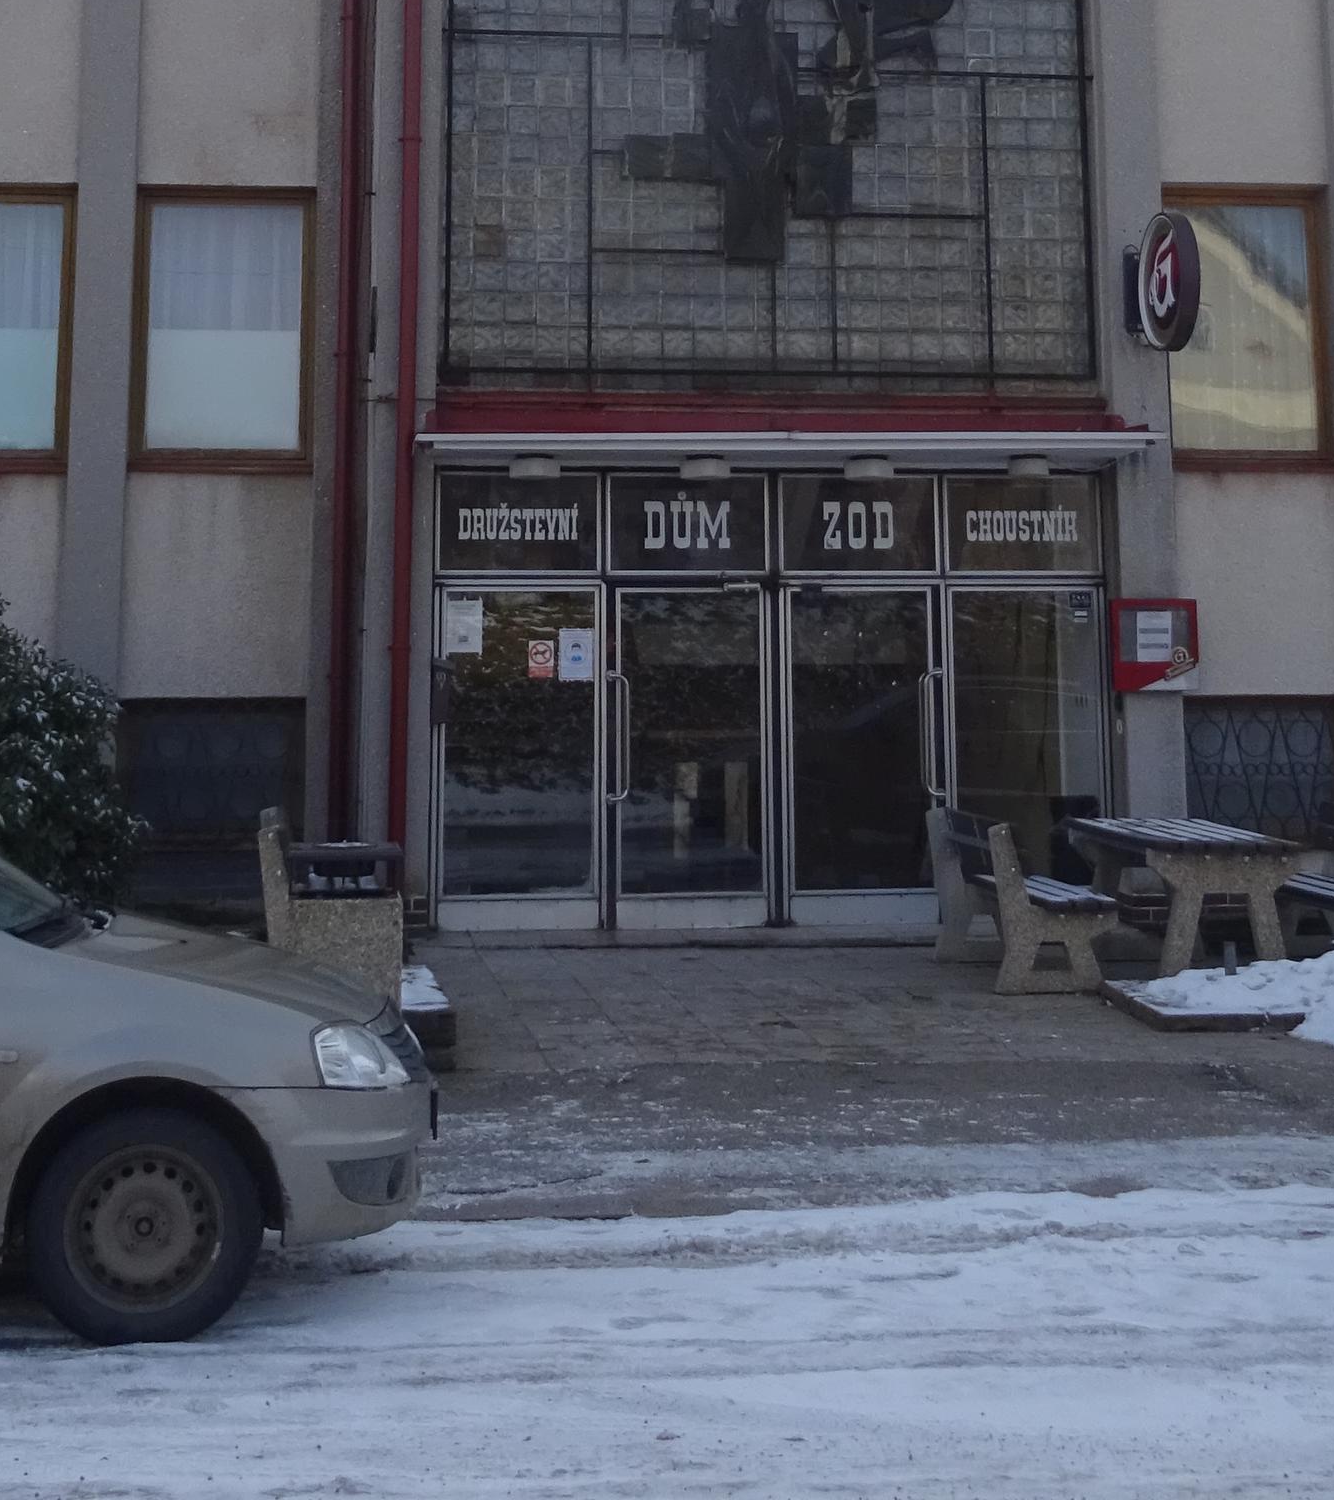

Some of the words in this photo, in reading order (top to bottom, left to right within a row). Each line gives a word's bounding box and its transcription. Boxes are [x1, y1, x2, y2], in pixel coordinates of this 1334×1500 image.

[458, 502, 578, 541] DRUŽSTEVNÍ
[644, 491, 731, 549] DŮM
[823, 501, 894, 549] ZOD
[966, 503, 1078, 542] CHOUSTNÍK
